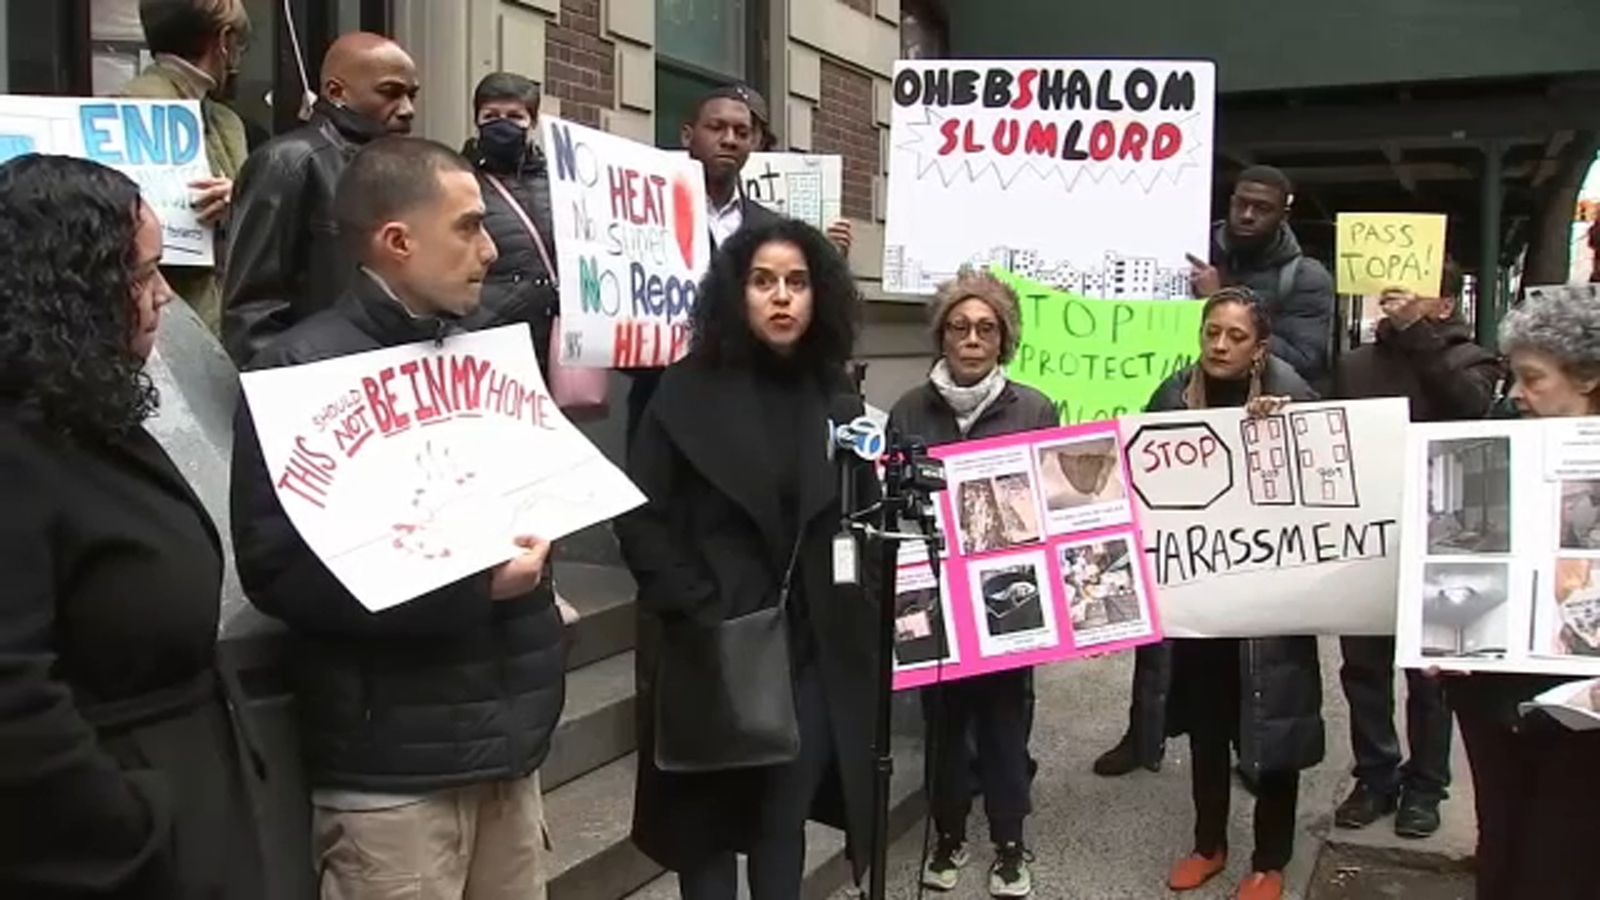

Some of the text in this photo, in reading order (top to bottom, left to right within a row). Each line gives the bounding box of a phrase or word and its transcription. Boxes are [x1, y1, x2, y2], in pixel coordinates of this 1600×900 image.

[894, 68, 1196, 112] OHEBSHALOM
[79, 103, 200, 165] END
[938, 118, 1183, 162] SLUMLORD
[551, 122, 667, 227] NO HEAT
[746, 161, 785, 205] nt.
[1351, 222, 1415, 248] PASS
[1341, 244, 1434, 283] TOPA!
[579, 255, 620, 317] NO
[614, 321, 686, 368] HELP
[1020, 344, 1192, 382] PROTECTIN
[278, 355, 557, 508] THIS SHOULD NOT BE IN MY HOME
[1142, 435, 1217, 473] STOP
[1143, 519, 1396, 585] HARASSMENT
